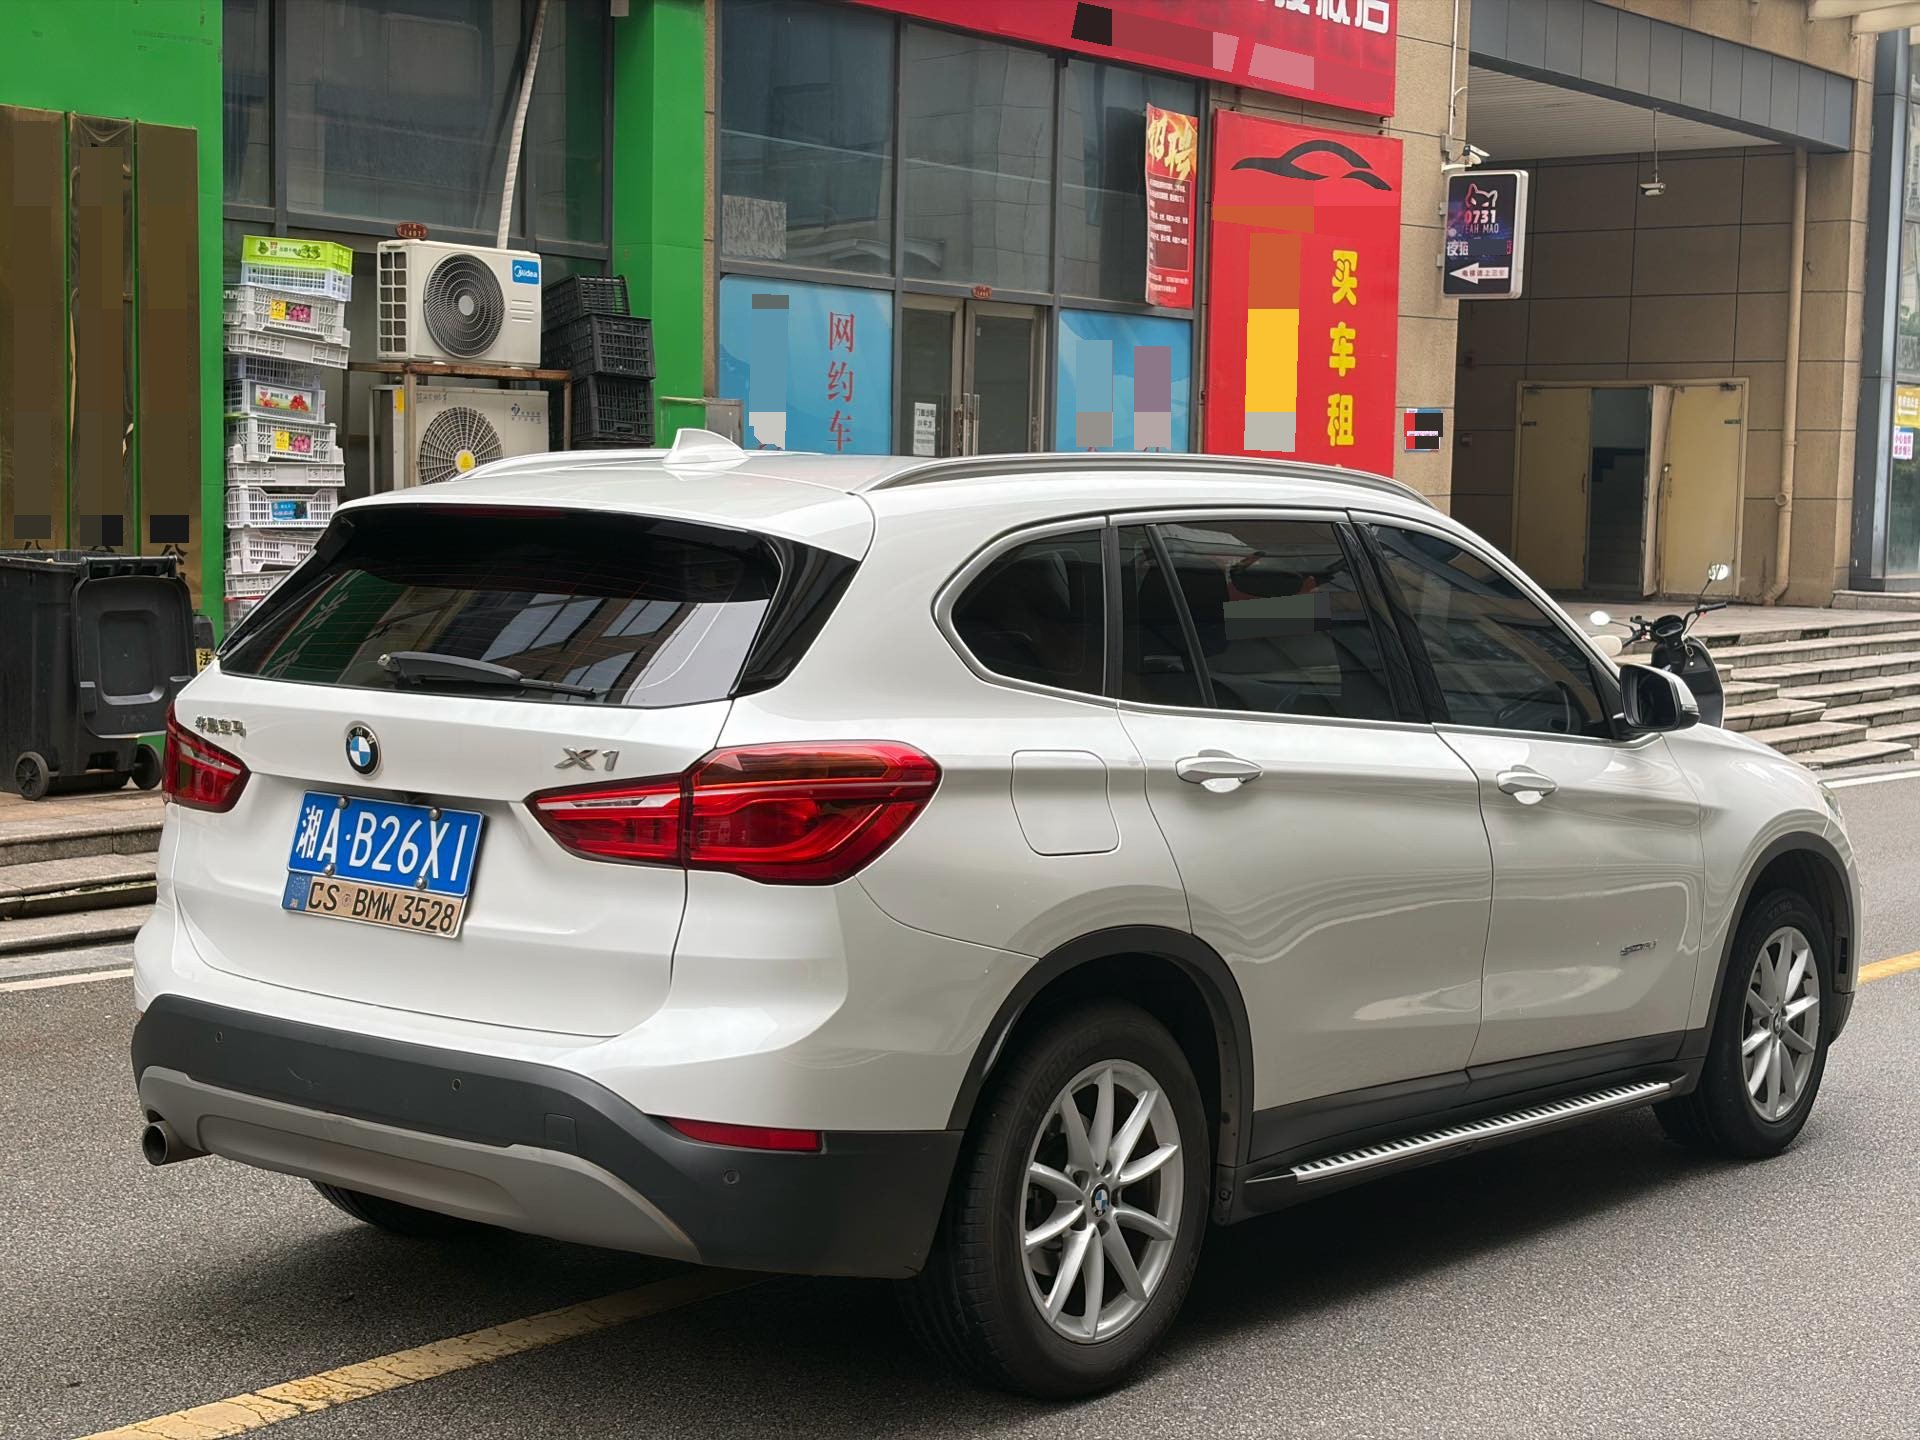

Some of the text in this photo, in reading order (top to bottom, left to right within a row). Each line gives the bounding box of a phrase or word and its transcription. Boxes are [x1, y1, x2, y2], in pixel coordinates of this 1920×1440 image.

[1148, 112, 1192, 181] 招聘
[1464, 210, 1497, 223] 0731
[1483, 223, 1499, 234] MAO
[514, 265, 538, 278] Midea
[1327, 249, 1358, 467] 买车租
[826, 312, 855, 451] 网约车
[347, 727, 376, 745] BMW
[554, 748, 620, 772] X1
[307, 881, 456, 933] CS BMW 3528
